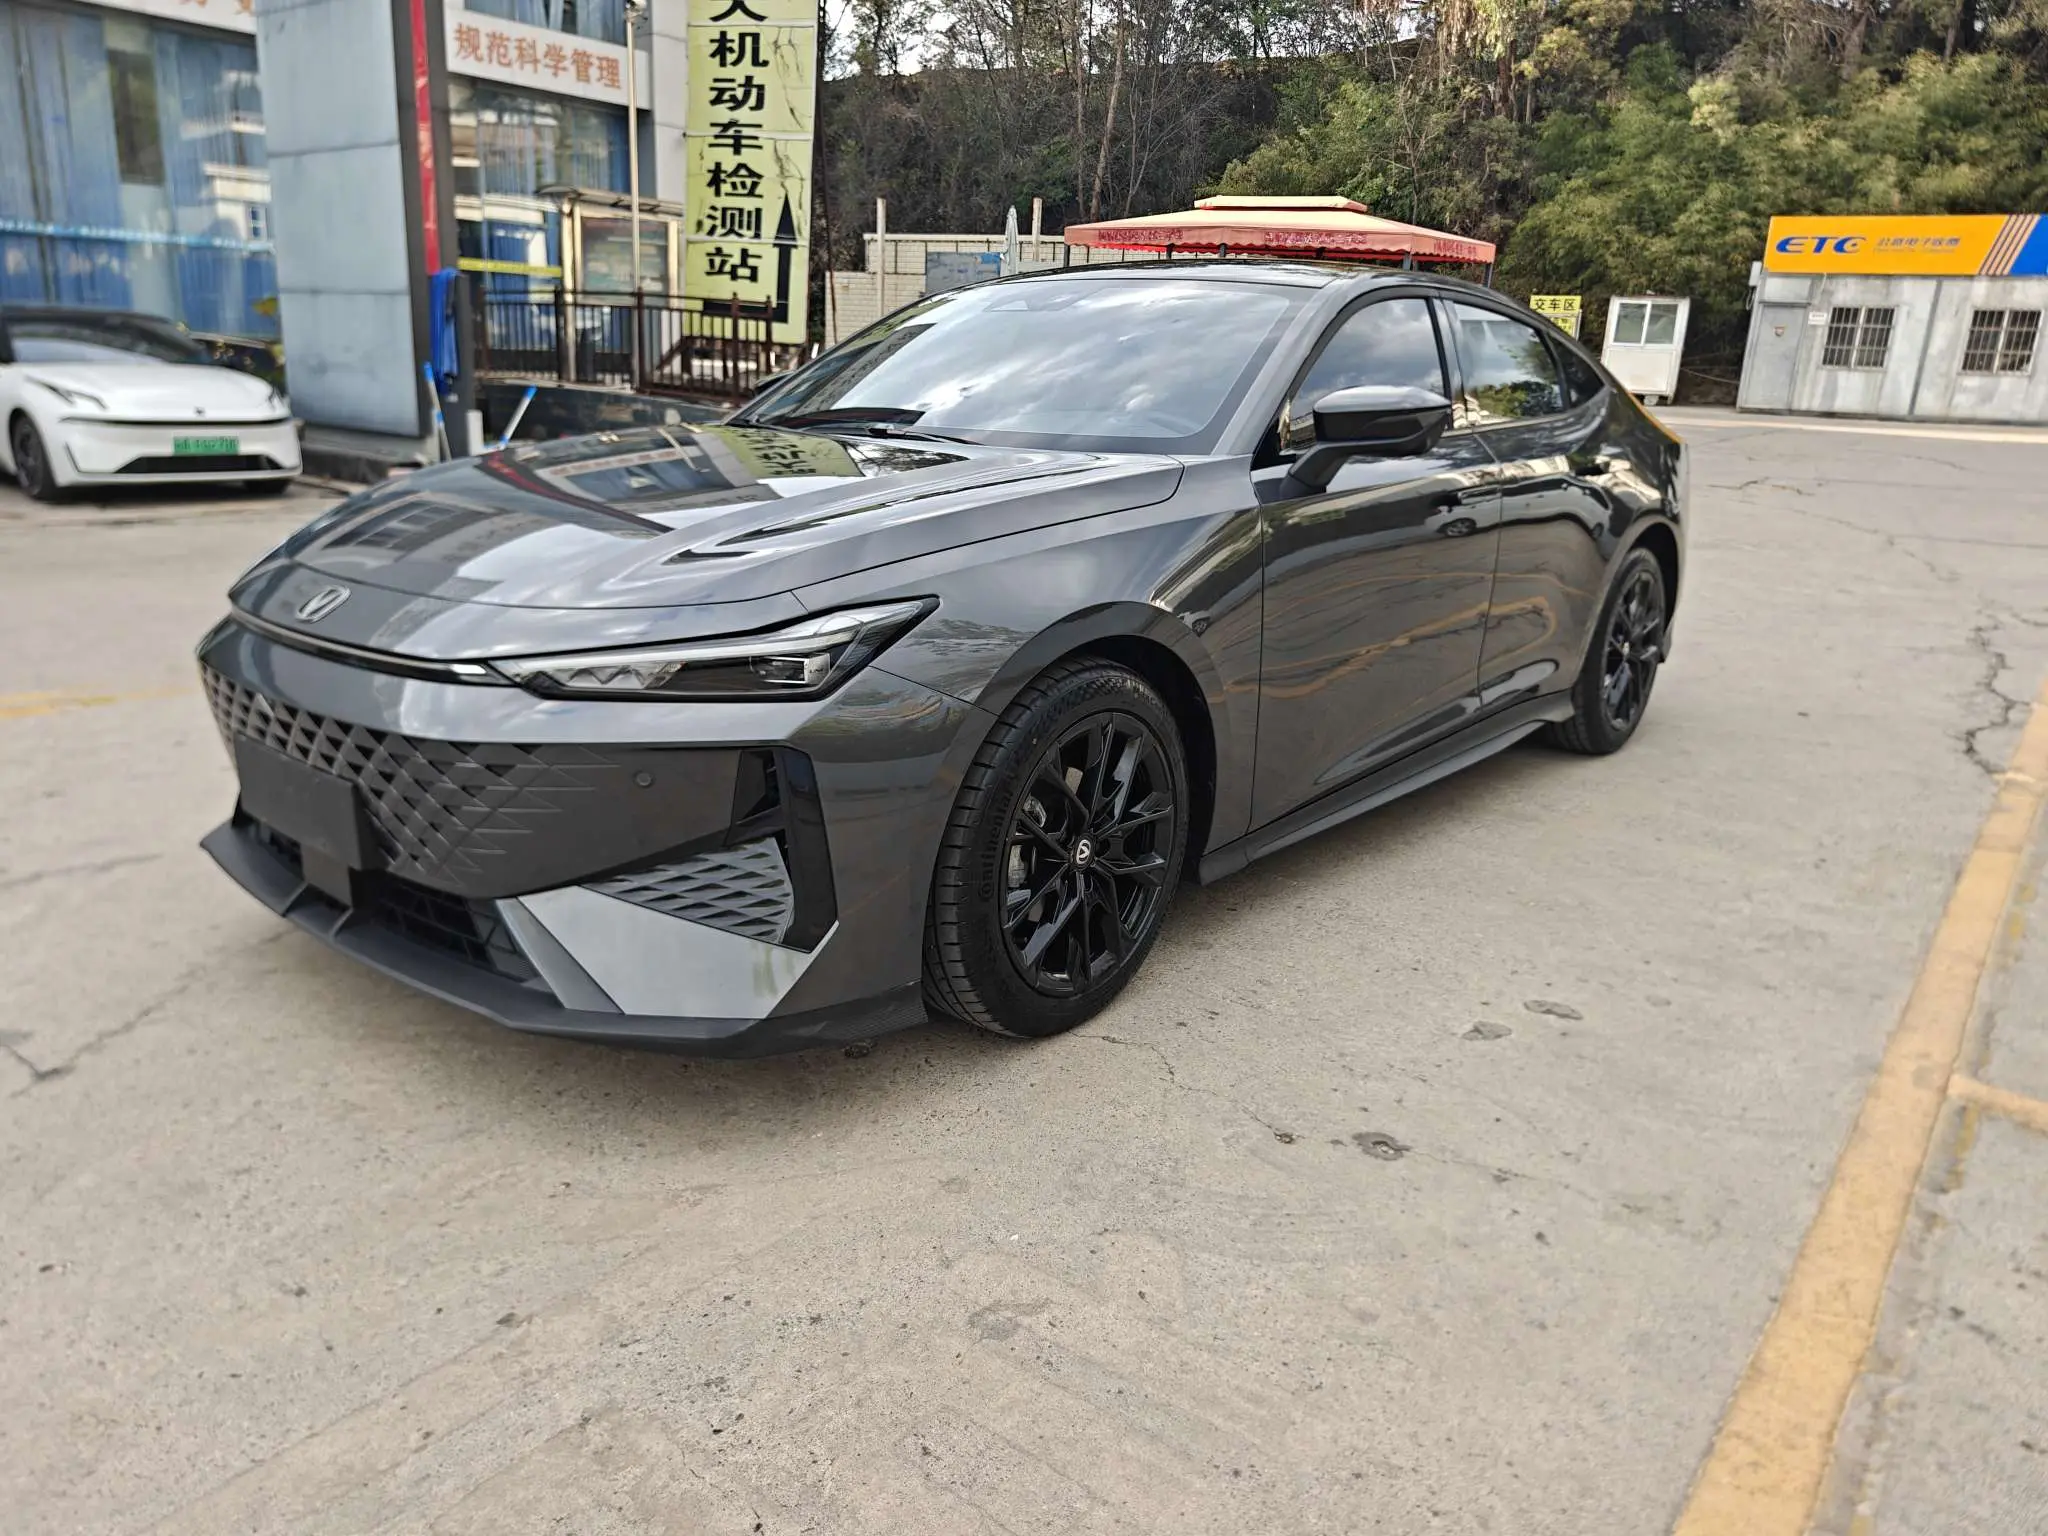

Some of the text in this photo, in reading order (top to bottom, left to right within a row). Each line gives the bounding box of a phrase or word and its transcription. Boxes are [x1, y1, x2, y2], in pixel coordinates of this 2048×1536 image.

[454, 22, 622, 90] 规范科学管理
[1776, 236, 1867, 254] ETC
[1533, 298, 1577, 311] 交车区
